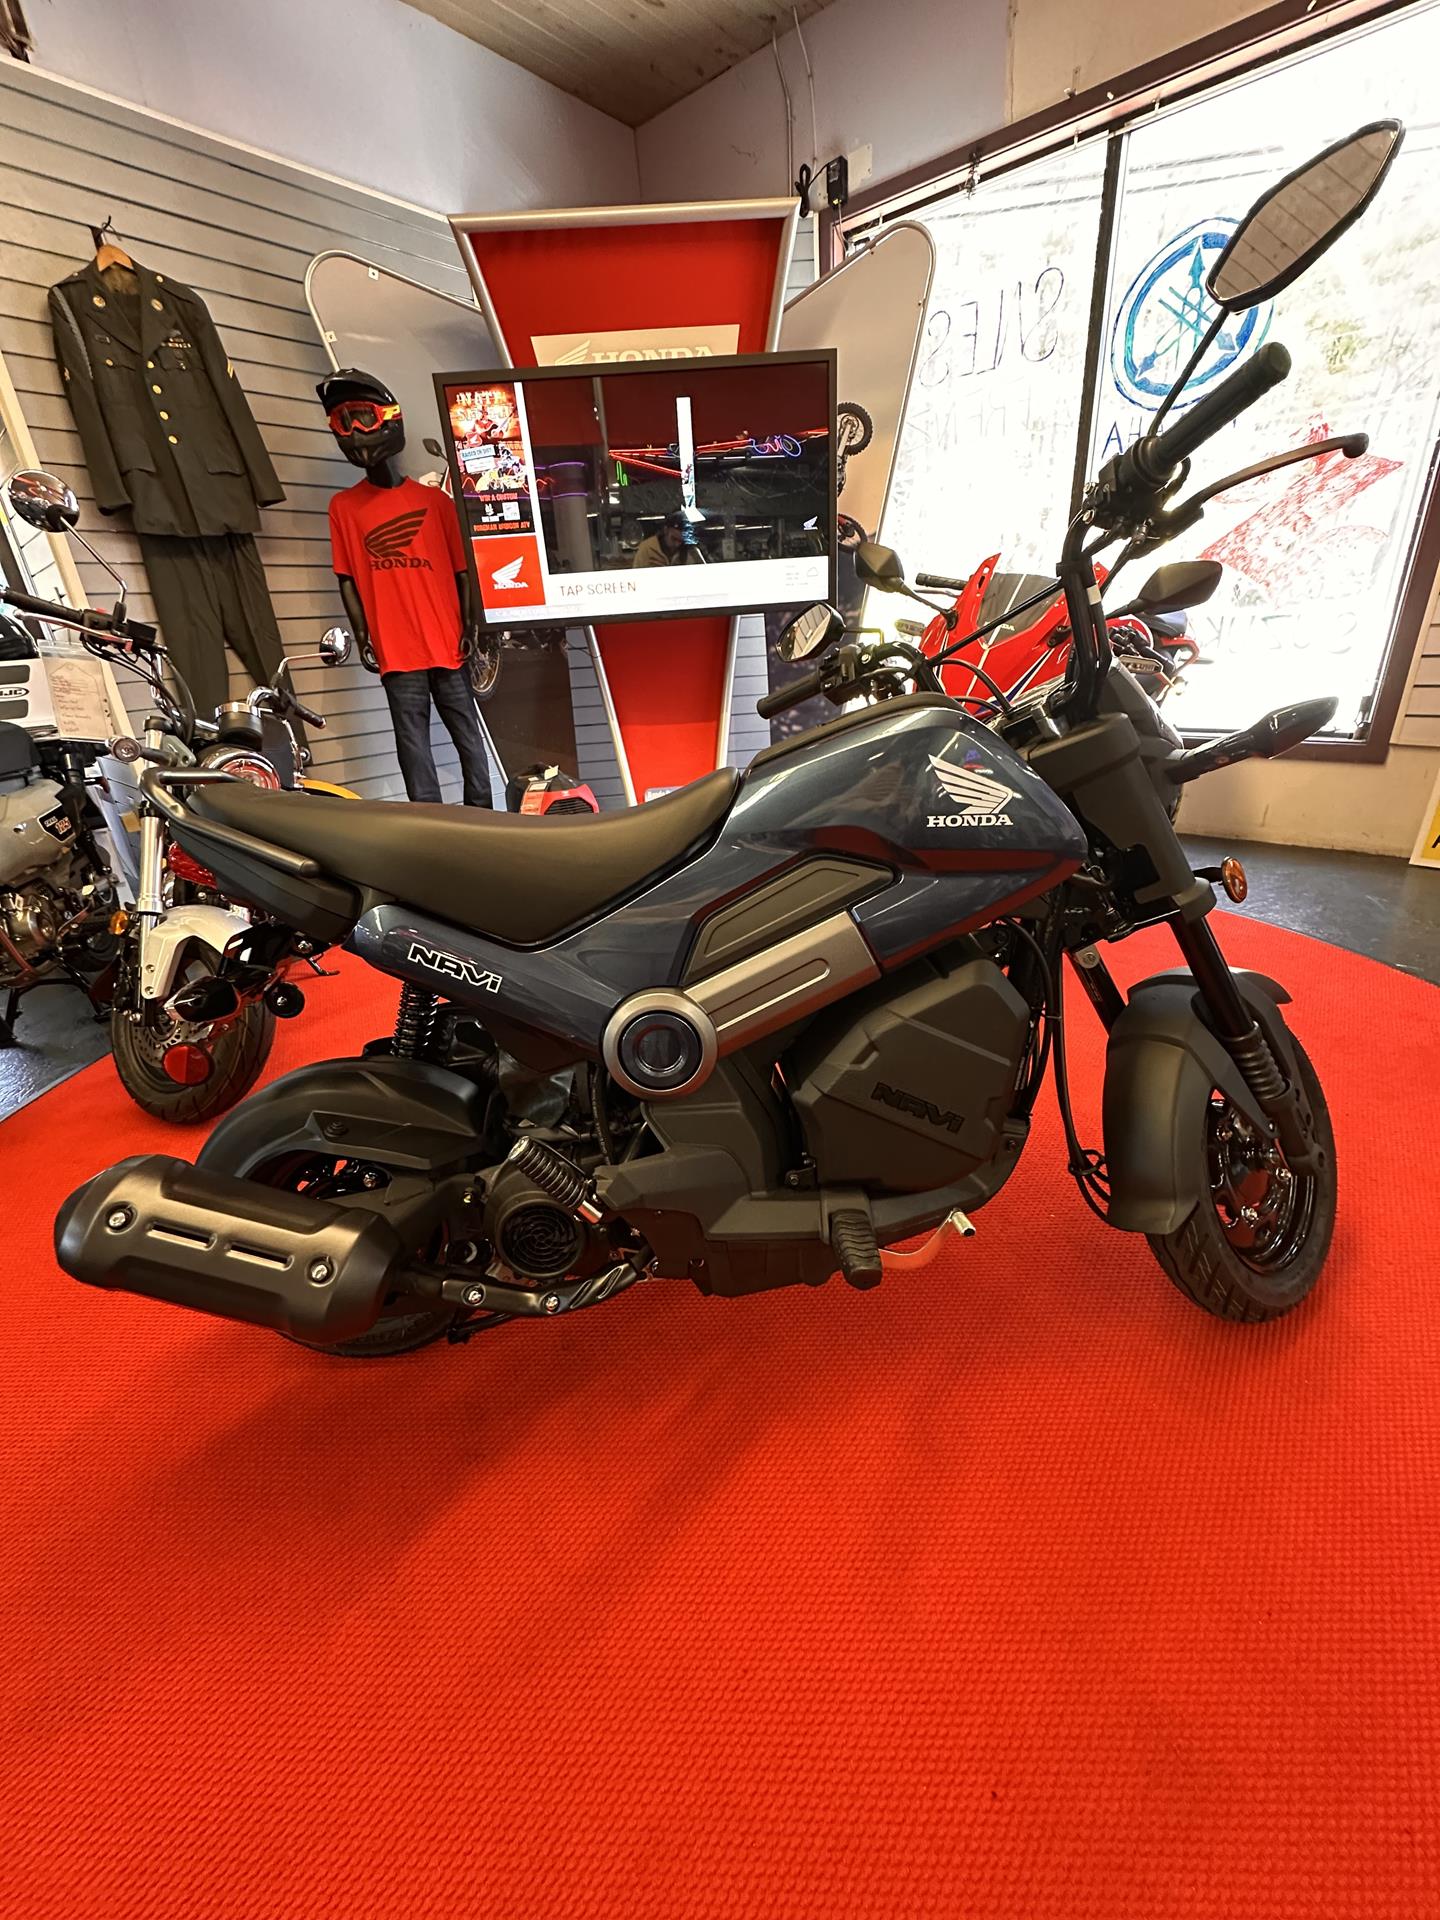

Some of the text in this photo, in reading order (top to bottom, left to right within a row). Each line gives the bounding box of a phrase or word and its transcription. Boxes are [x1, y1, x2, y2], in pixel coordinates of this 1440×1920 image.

[592, 345, 713, 364] HONDA
[371, 557, 434, 571] HONDA
[560, 582, 637, 598] TAP SCREEN
[926, 814, 1014, 828] HONDA
